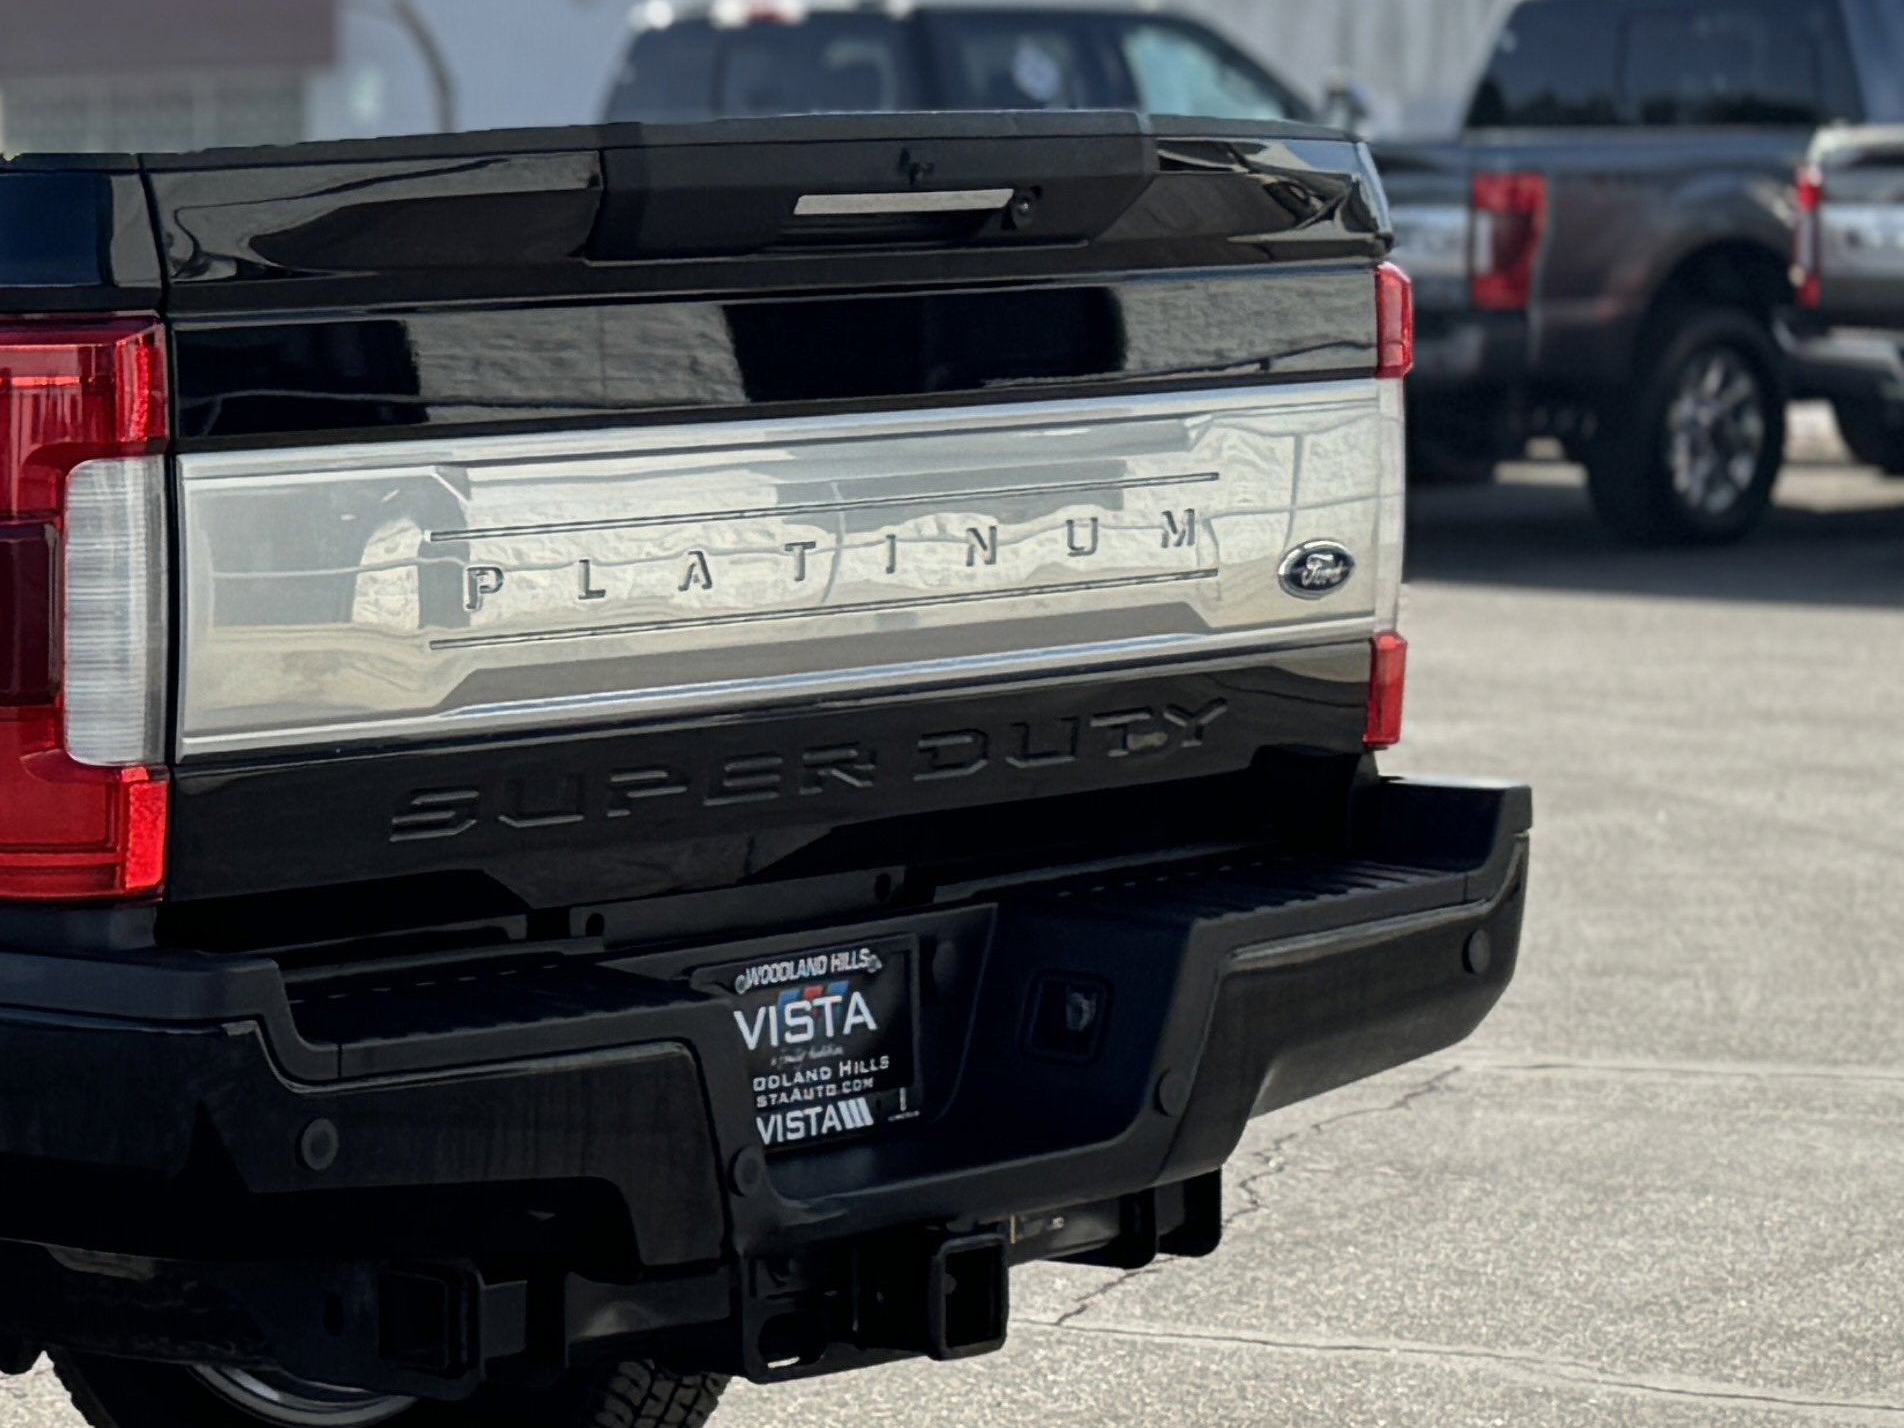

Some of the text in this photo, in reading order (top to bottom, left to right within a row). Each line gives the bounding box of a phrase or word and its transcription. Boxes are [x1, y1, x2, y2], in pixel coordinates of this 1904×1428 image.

[465, 508, 1198, 609] PLATINUM
[391, 697, 1229, 844] SUPER DUTY
[830, 948, 871, 974] HILLS
[733, 992, 878, 1050] VISTA
[839, 1056, 890, 1077] HILLS
[755, 1099, 843, 1146] VISTA
